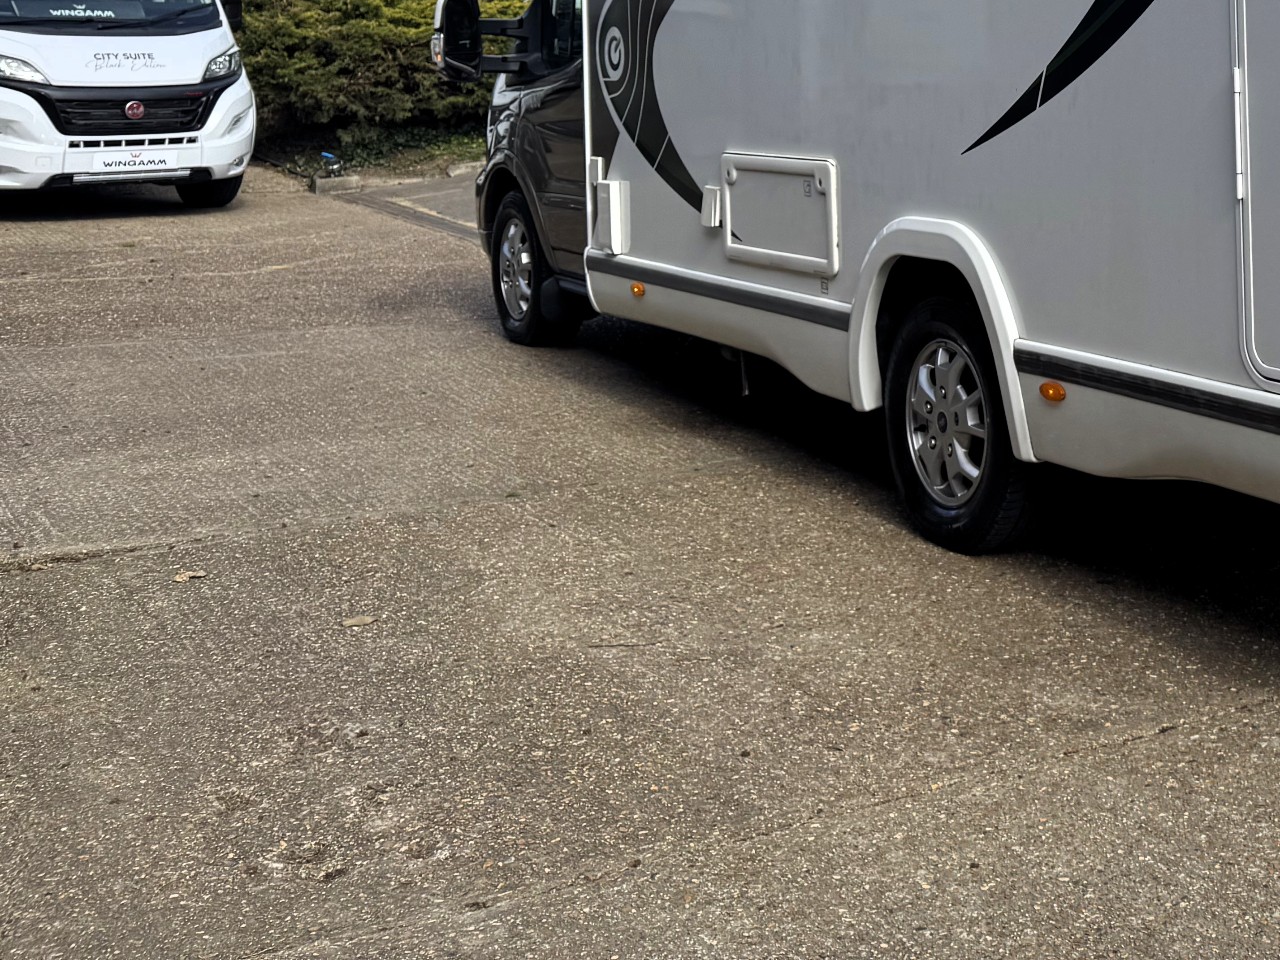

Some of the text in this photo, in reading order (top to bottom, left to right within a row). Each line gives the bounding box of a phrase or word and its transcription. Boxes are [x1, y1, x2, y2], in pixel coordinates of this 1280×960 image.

[49, 9, 115, 18] WINGAMM
[93, 52, 155, 61] CITY SUITE
[103, 159, 167, 168] WINGAMM
